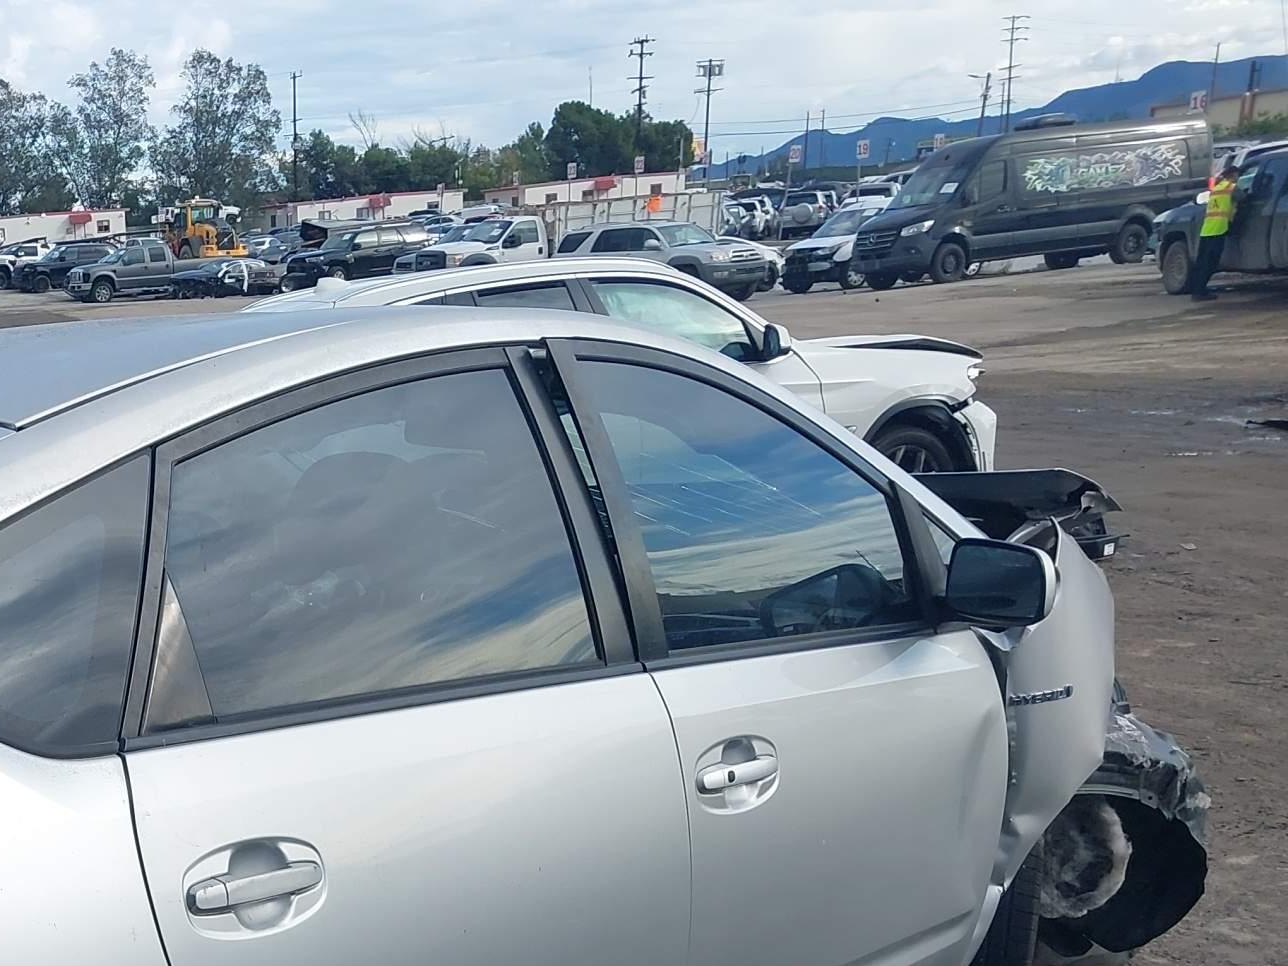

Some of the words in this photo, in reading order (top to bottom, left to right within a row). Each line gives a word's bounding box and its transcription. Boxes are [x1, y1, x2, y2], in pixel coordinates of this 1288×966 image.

[1192, 95, 1208, 110] 16
[790, 148, 801, 159] 20
[858, 143, 869, 156] 19
[1009, 684, 1073, 706] HYBRID
